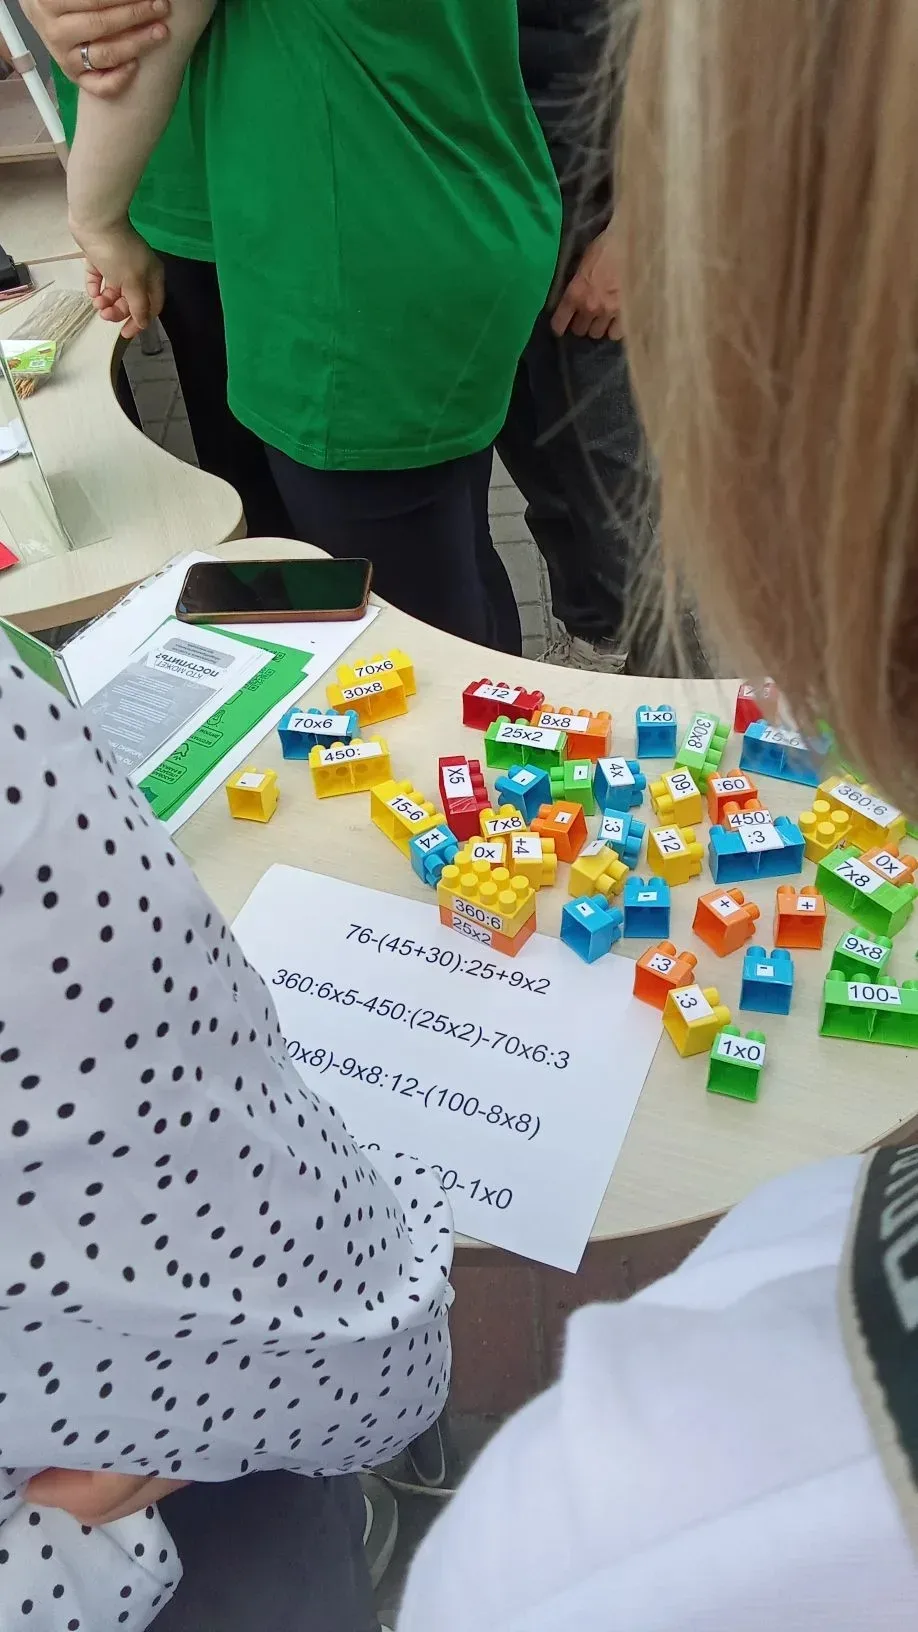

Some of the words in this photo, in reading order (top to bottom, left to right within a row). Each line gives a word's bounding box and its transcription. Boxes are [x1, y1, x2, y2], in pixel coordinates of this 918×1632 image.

[155, 653, 220, 678] ПОСТУПИТЬ?
[156, 660, 187, 674] МОЖЕТ
[355, 660, 394, 677] 70x6
[186, 671, 204, 679] КТО
[343, 682, 384, 699] 30x8
[483, 688, 510, 699] :12
[293, 717, 333, 729] 70x6
[541, 714, 571, 728] 8x8
[643, 712, 673, 722] 1x0
[502, 727, 543, 743] 25x2
[687, 718, 711, 749] 30x8
[324, 748, 361, 762] 450:
[718, 778, 745, 791] :60
[838, 785, 888, 816] 360:6
[391, 797, 424, 821] 15-6
[489, 816, 522, 832] 7x8
[731, 811, 772, 826] 450:
[657, 831, 681, 852] :12
[748, 831, 765, 845] :3
[836, 861, 870, 887] 7x8
[455, 900, 501, 930] 360:6
[452, 917, 491, 945] 25x2
[845, 937, 883, 960] 9x8
[345, 923, 551, 995] 76-(45+30):25+9x2
[651, 957, 672, 972] :3
[676, 993, 697, 1008] :3
[850, 985, 898, 1001] 100-
[724, 1040, 760, 1060] 1x0
[431, 1165, 513, 1209] 0-1x0
